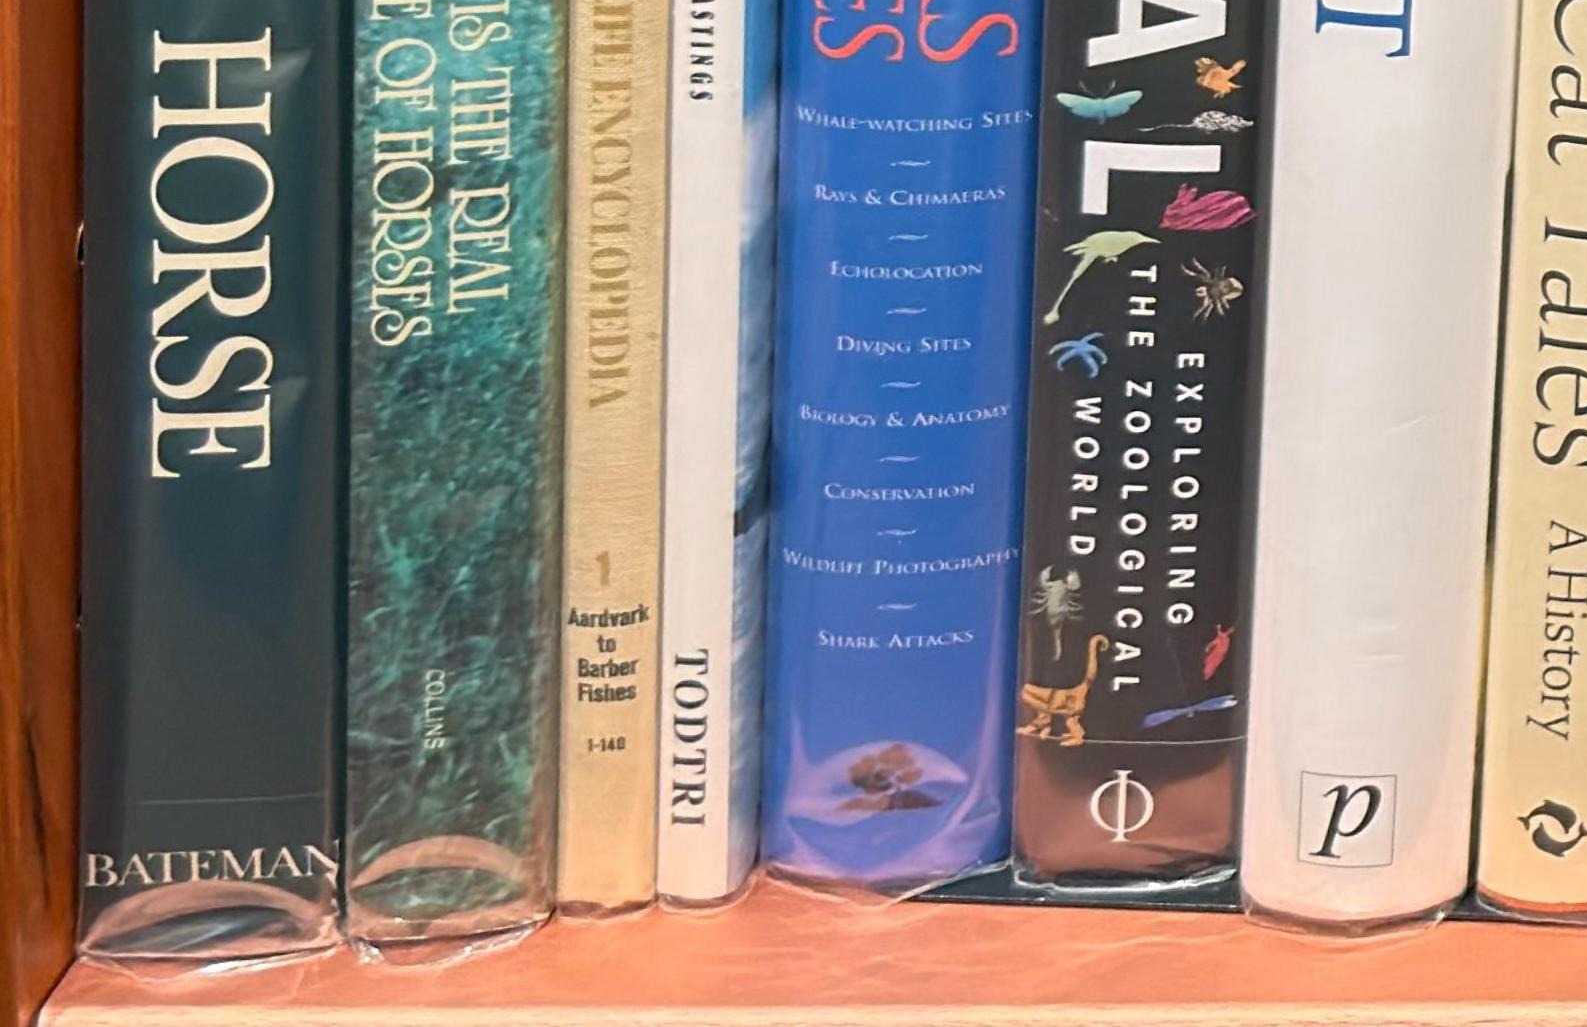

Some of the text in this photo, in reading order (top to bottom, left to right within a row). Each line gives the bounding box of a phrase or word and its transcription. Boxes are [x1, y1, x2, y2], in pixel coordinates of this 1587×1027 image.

[374, 37, 437, 114] OF
[449, 65, 515, 166] THE
[370, 127, 434, 347] HORSES
[864, 188, 882, 206] &
[150, 28, 276, 480] HORSE
[445, 181, 513, 314] REAL
[587, 78, 635, 410] ENCYCLOPEDIA
[887, 410, 904, 427] &
[1066, 396, 1103, 557] WORLD
[1111, 262, 1157, 693] THE ZOOLOGICAL
[1164, 351, 1206, 628] EXPLORING
[567, 603, 650, 628] Aardvark
[596, 634, 617, 654] to
[423, 669, 446, 751] COLLINS
[577, 657, 639, 678] Barber
[577, 682, 638, 703] Fishes
[671, 648, 710, 827] TODTRI
[84, 838, 340, 887] BATEMAN
